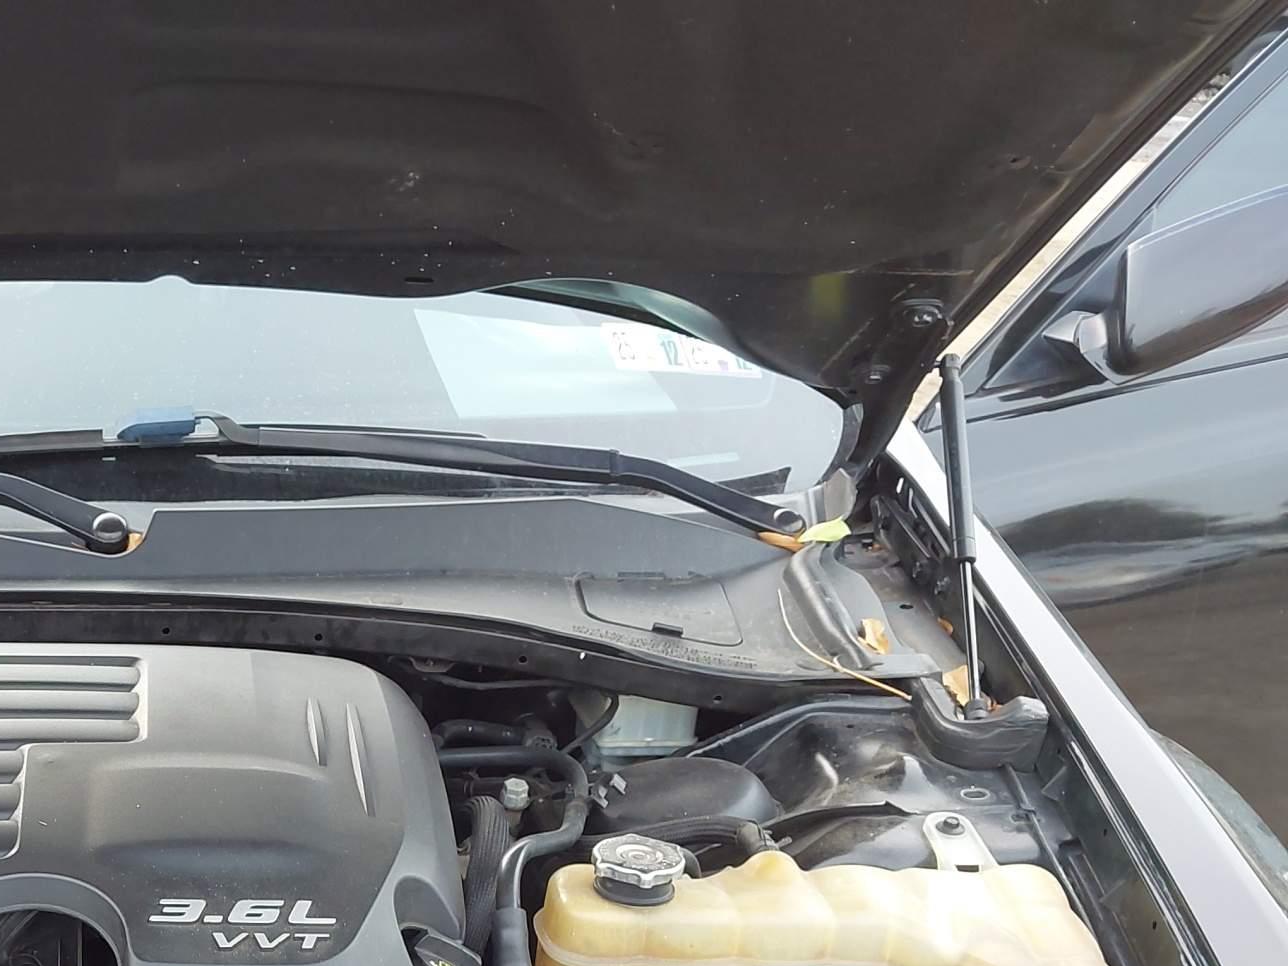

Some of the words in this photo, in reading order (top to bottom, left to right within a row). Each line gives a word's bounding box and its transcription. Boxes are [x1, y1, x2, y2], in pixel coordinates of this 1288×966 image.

[660, 339, 684, 367] 12
[148, 898, 338, 926] 3.6L
[212, 932, 331, 950] VVT
